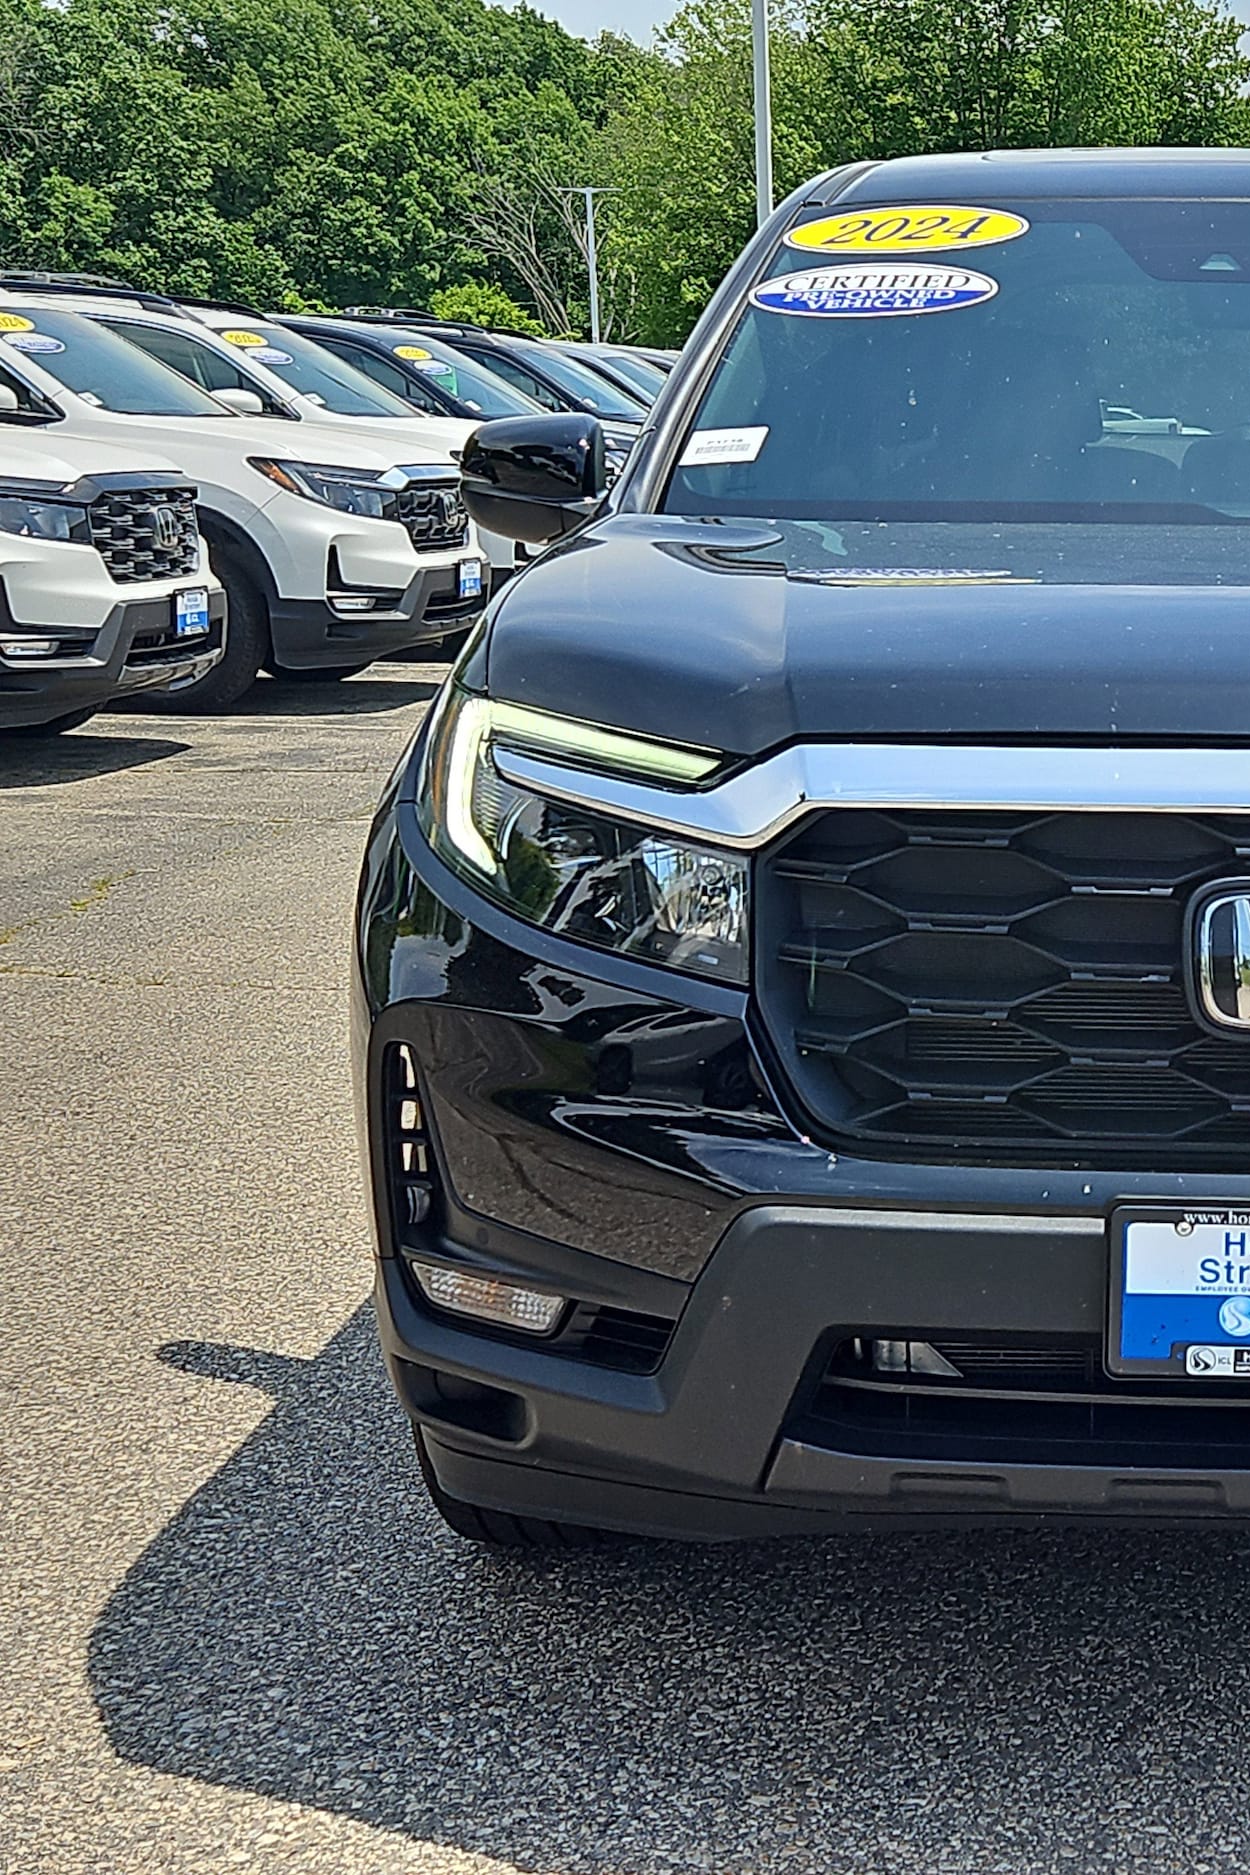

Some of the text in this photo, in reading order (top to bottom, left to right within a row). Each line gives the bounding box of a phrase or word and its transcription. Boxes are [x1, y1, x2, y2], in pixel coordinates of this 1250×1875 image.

[820, 215, 991, 245] 2024
[784, 274, 971, 291] CERTIFIED
[783, 289, 957, 302] PRE-OWNED
[808, 299, 930, 310] VEHICLE
